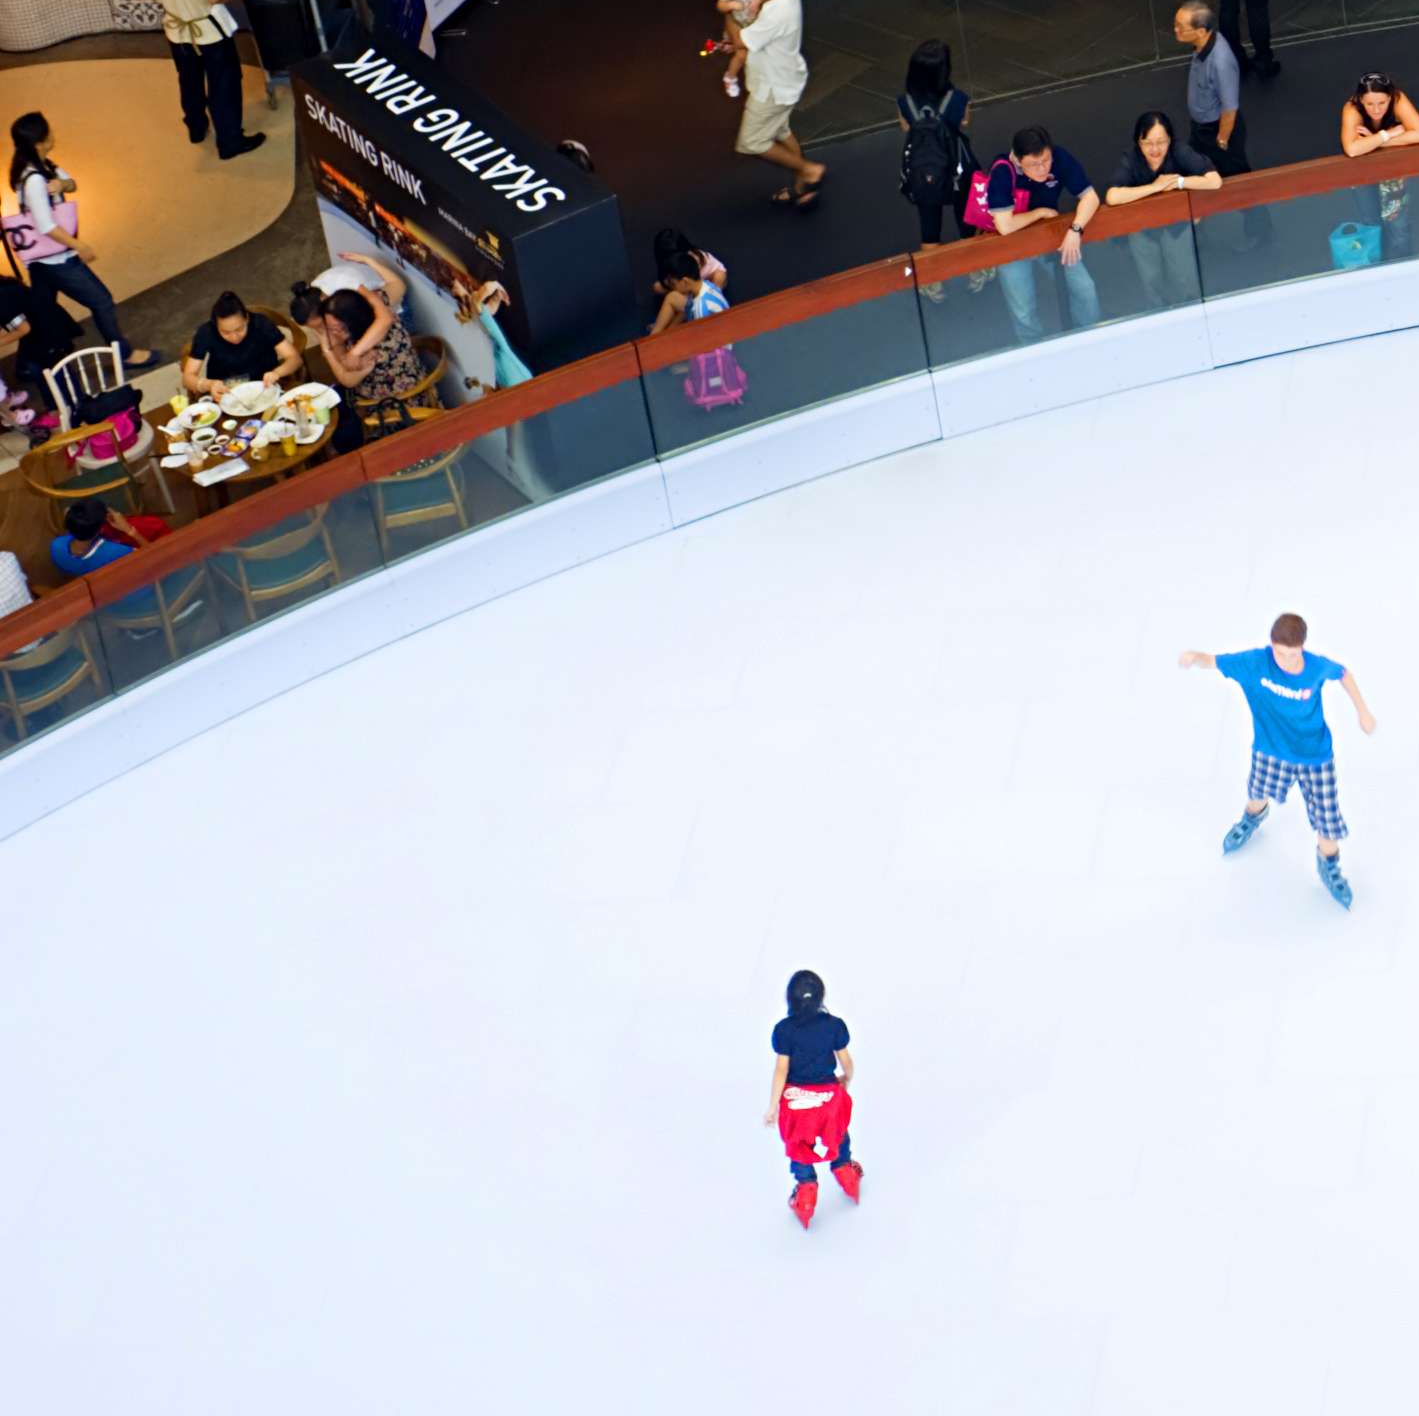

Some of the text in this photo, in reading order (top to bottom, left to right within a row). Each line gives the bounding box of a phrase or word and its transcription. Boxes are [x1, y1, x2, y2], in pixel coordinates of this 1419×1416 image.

[304, 94, 427, 205] SKATING RINK
[333, 48, 566, 213] SKATING RINK
